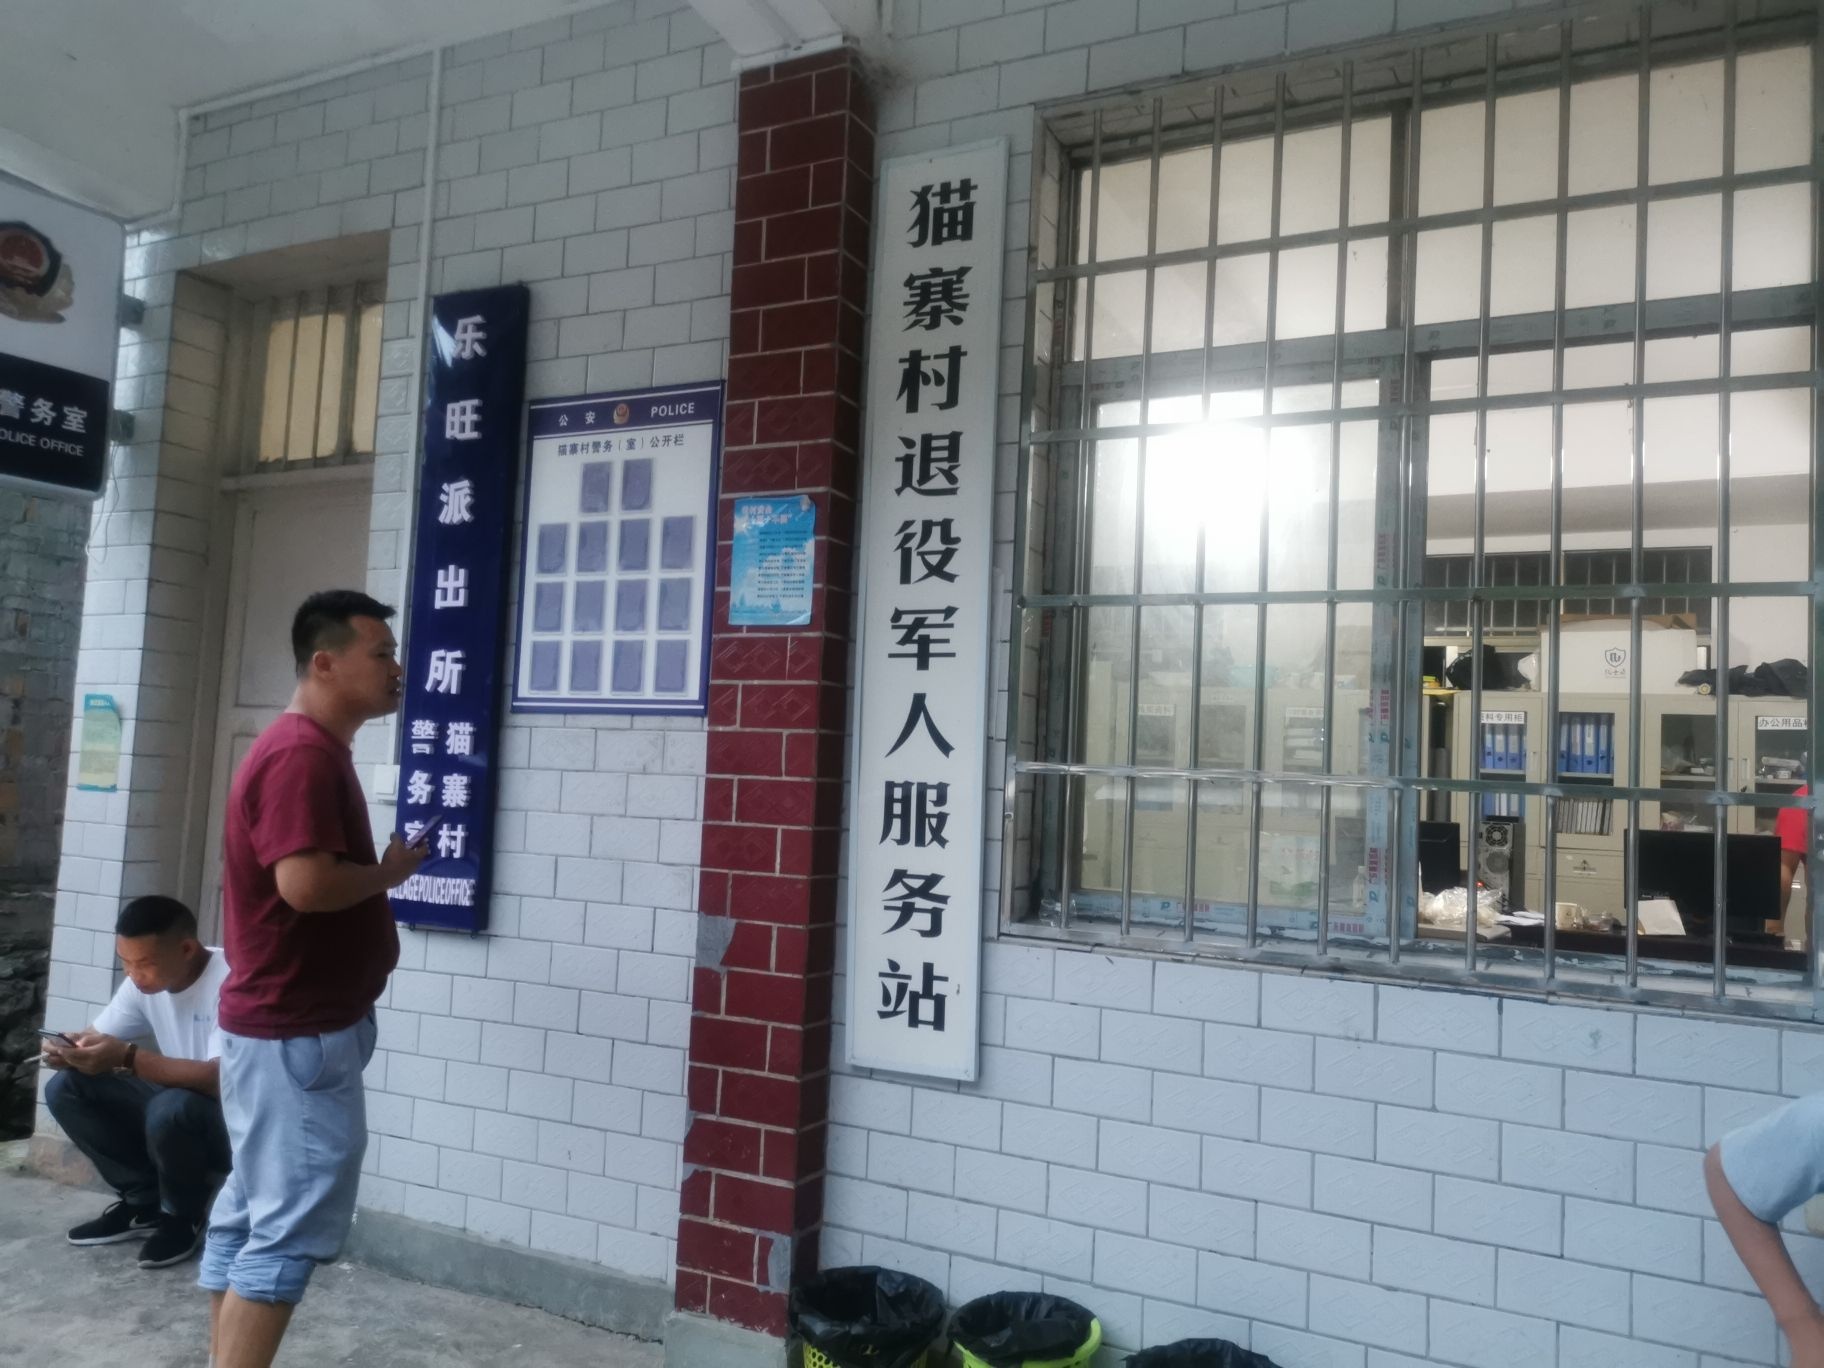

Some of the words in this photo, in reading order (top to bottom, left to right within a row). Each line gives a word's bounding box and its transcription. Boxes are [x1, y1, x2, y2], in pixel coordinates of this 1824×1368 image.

[0, 388, 88, 434] 警务室
[558, 410, 597, 427] 公安
[650, 402, 696, 418] POLICE
[40, 437, 85, 457] OFFICE
[424, 314, 488, 696] 乐旺派出所
[877, 178, 979, 1032] 猫寨村退役军人服务站
